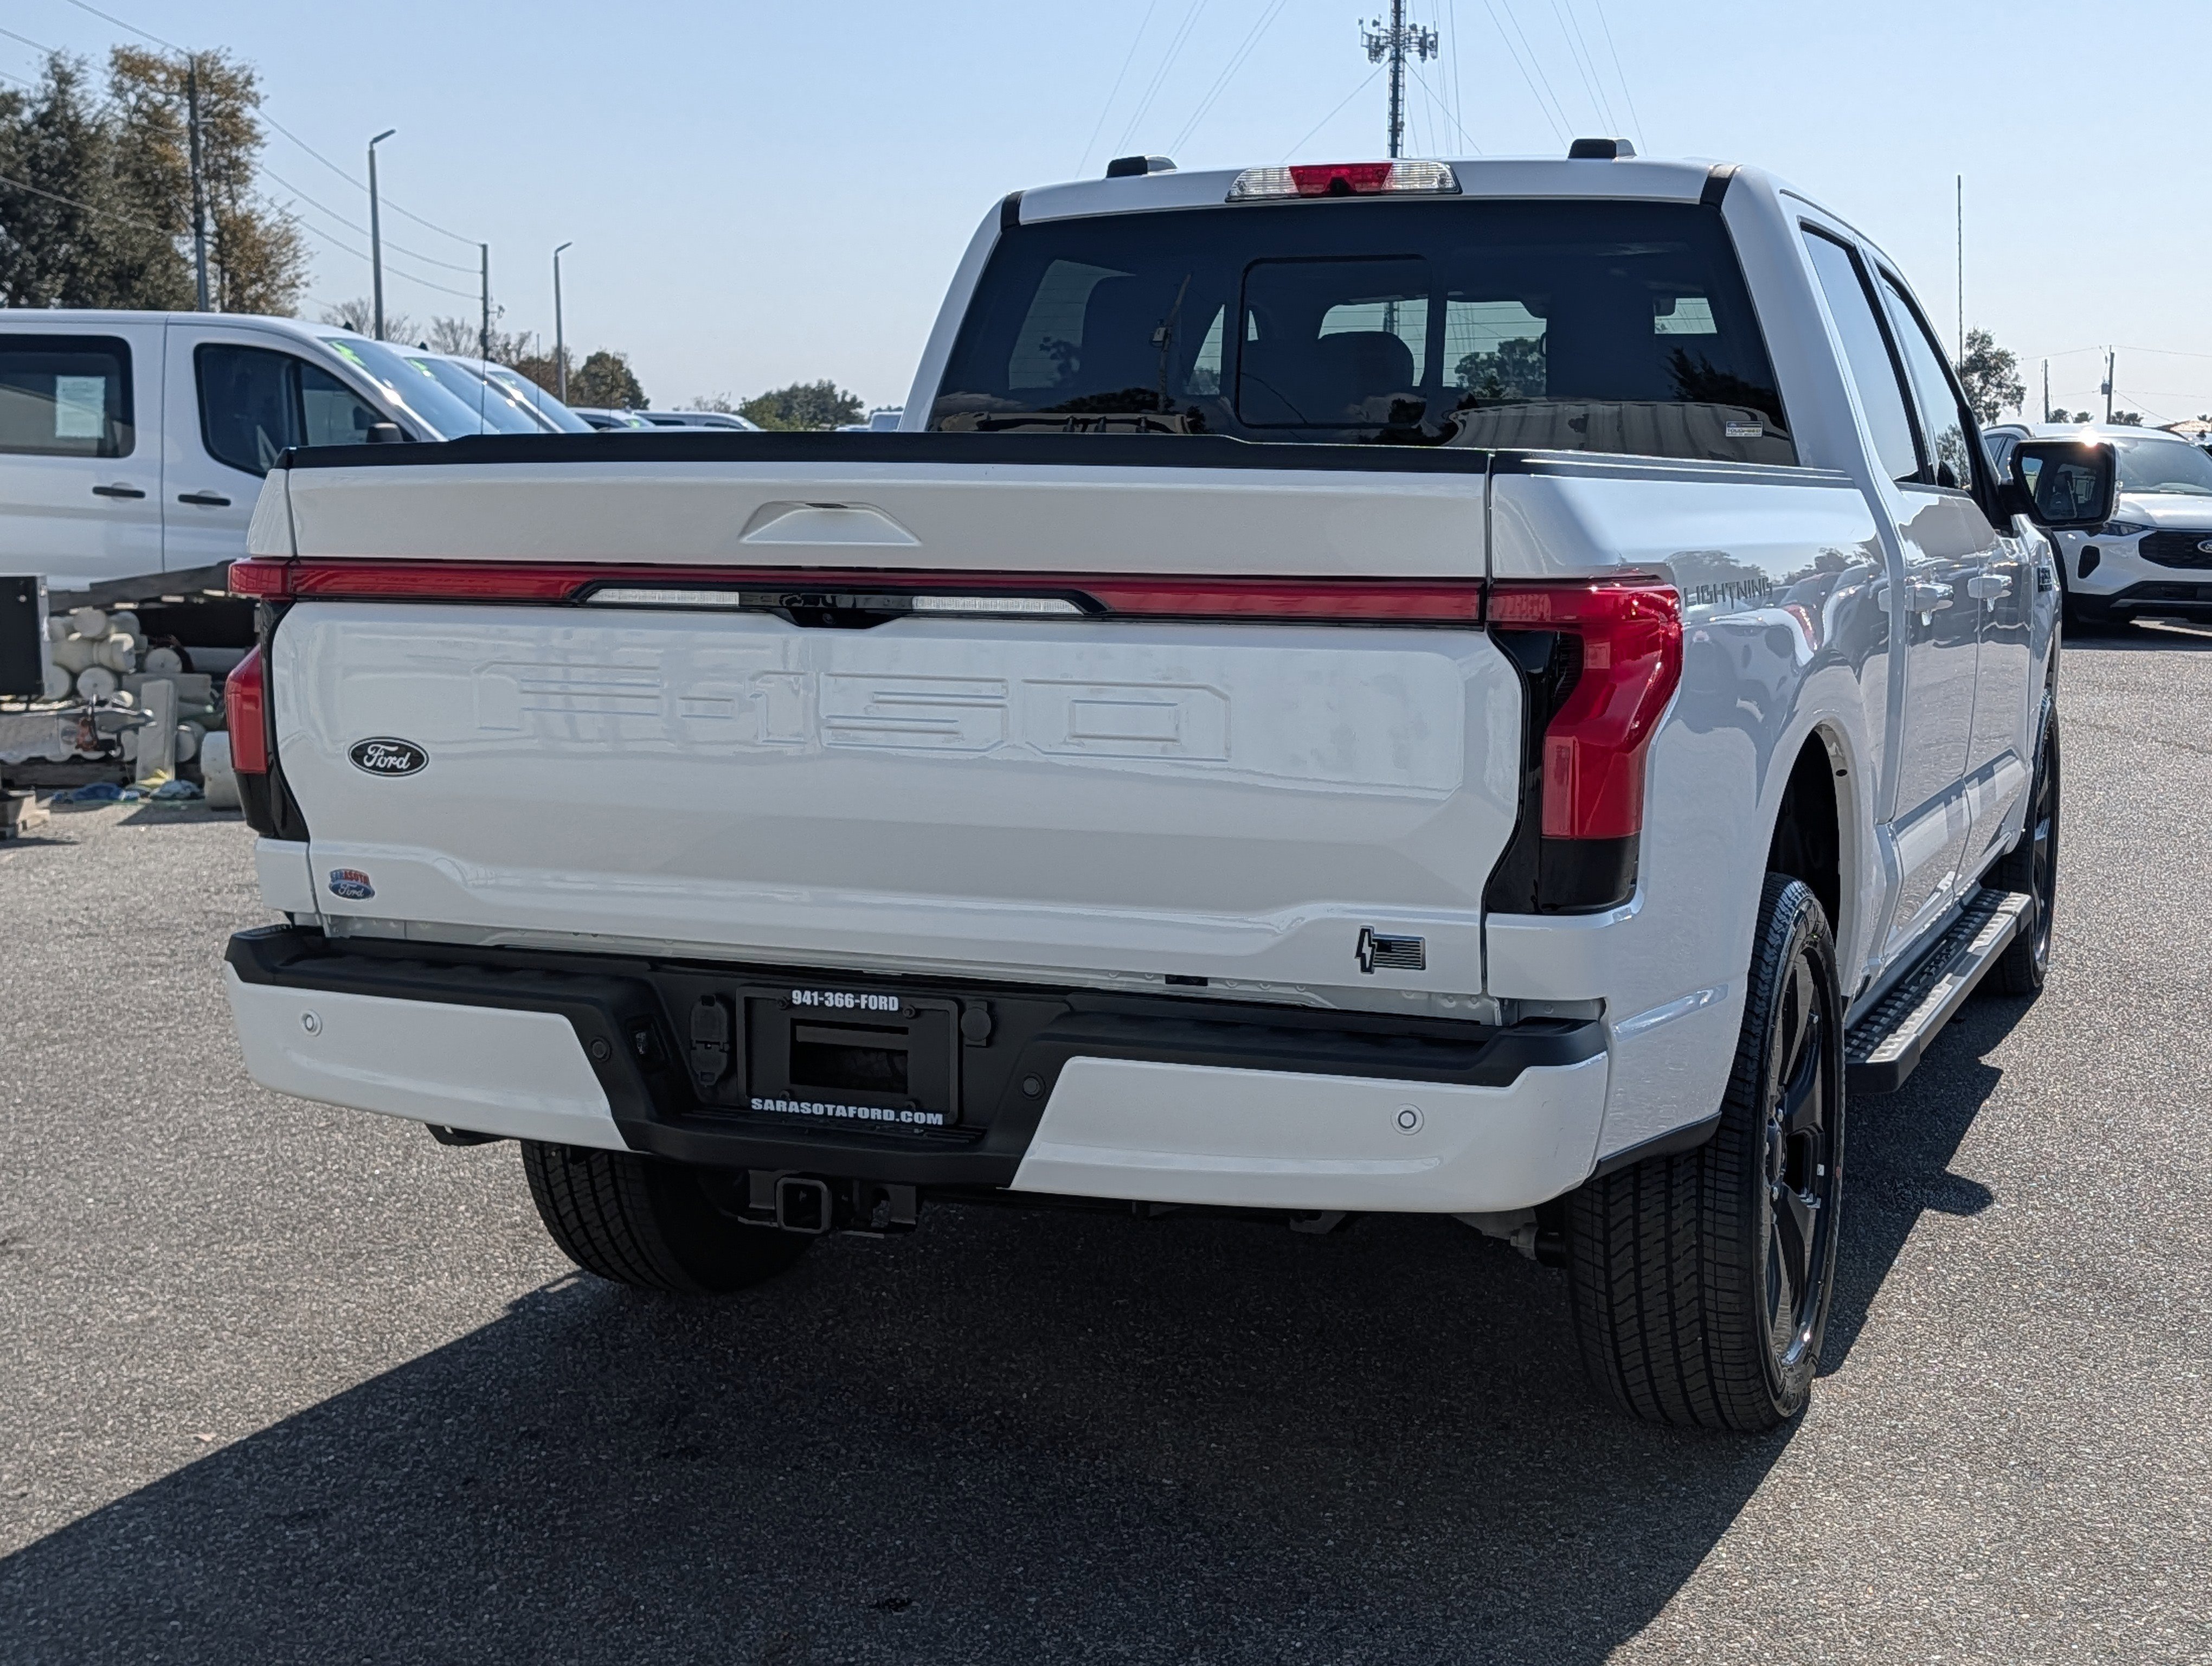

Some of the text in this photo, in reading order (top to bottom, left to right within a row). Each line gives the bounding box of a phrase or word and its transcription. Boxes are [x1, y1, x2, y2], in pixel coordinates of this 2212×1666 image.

[1683, 577, 1772, 610] LIGHTNING
[472, 660, 1232, 762] F-150
[363, 744, 411, 770] Ford
[338, 883, 364, 897] Ford
[792, 990, 899, 1011] 941-366-FORD
[751, 1098, 944, 1125] SARASOTAFORD.COM
